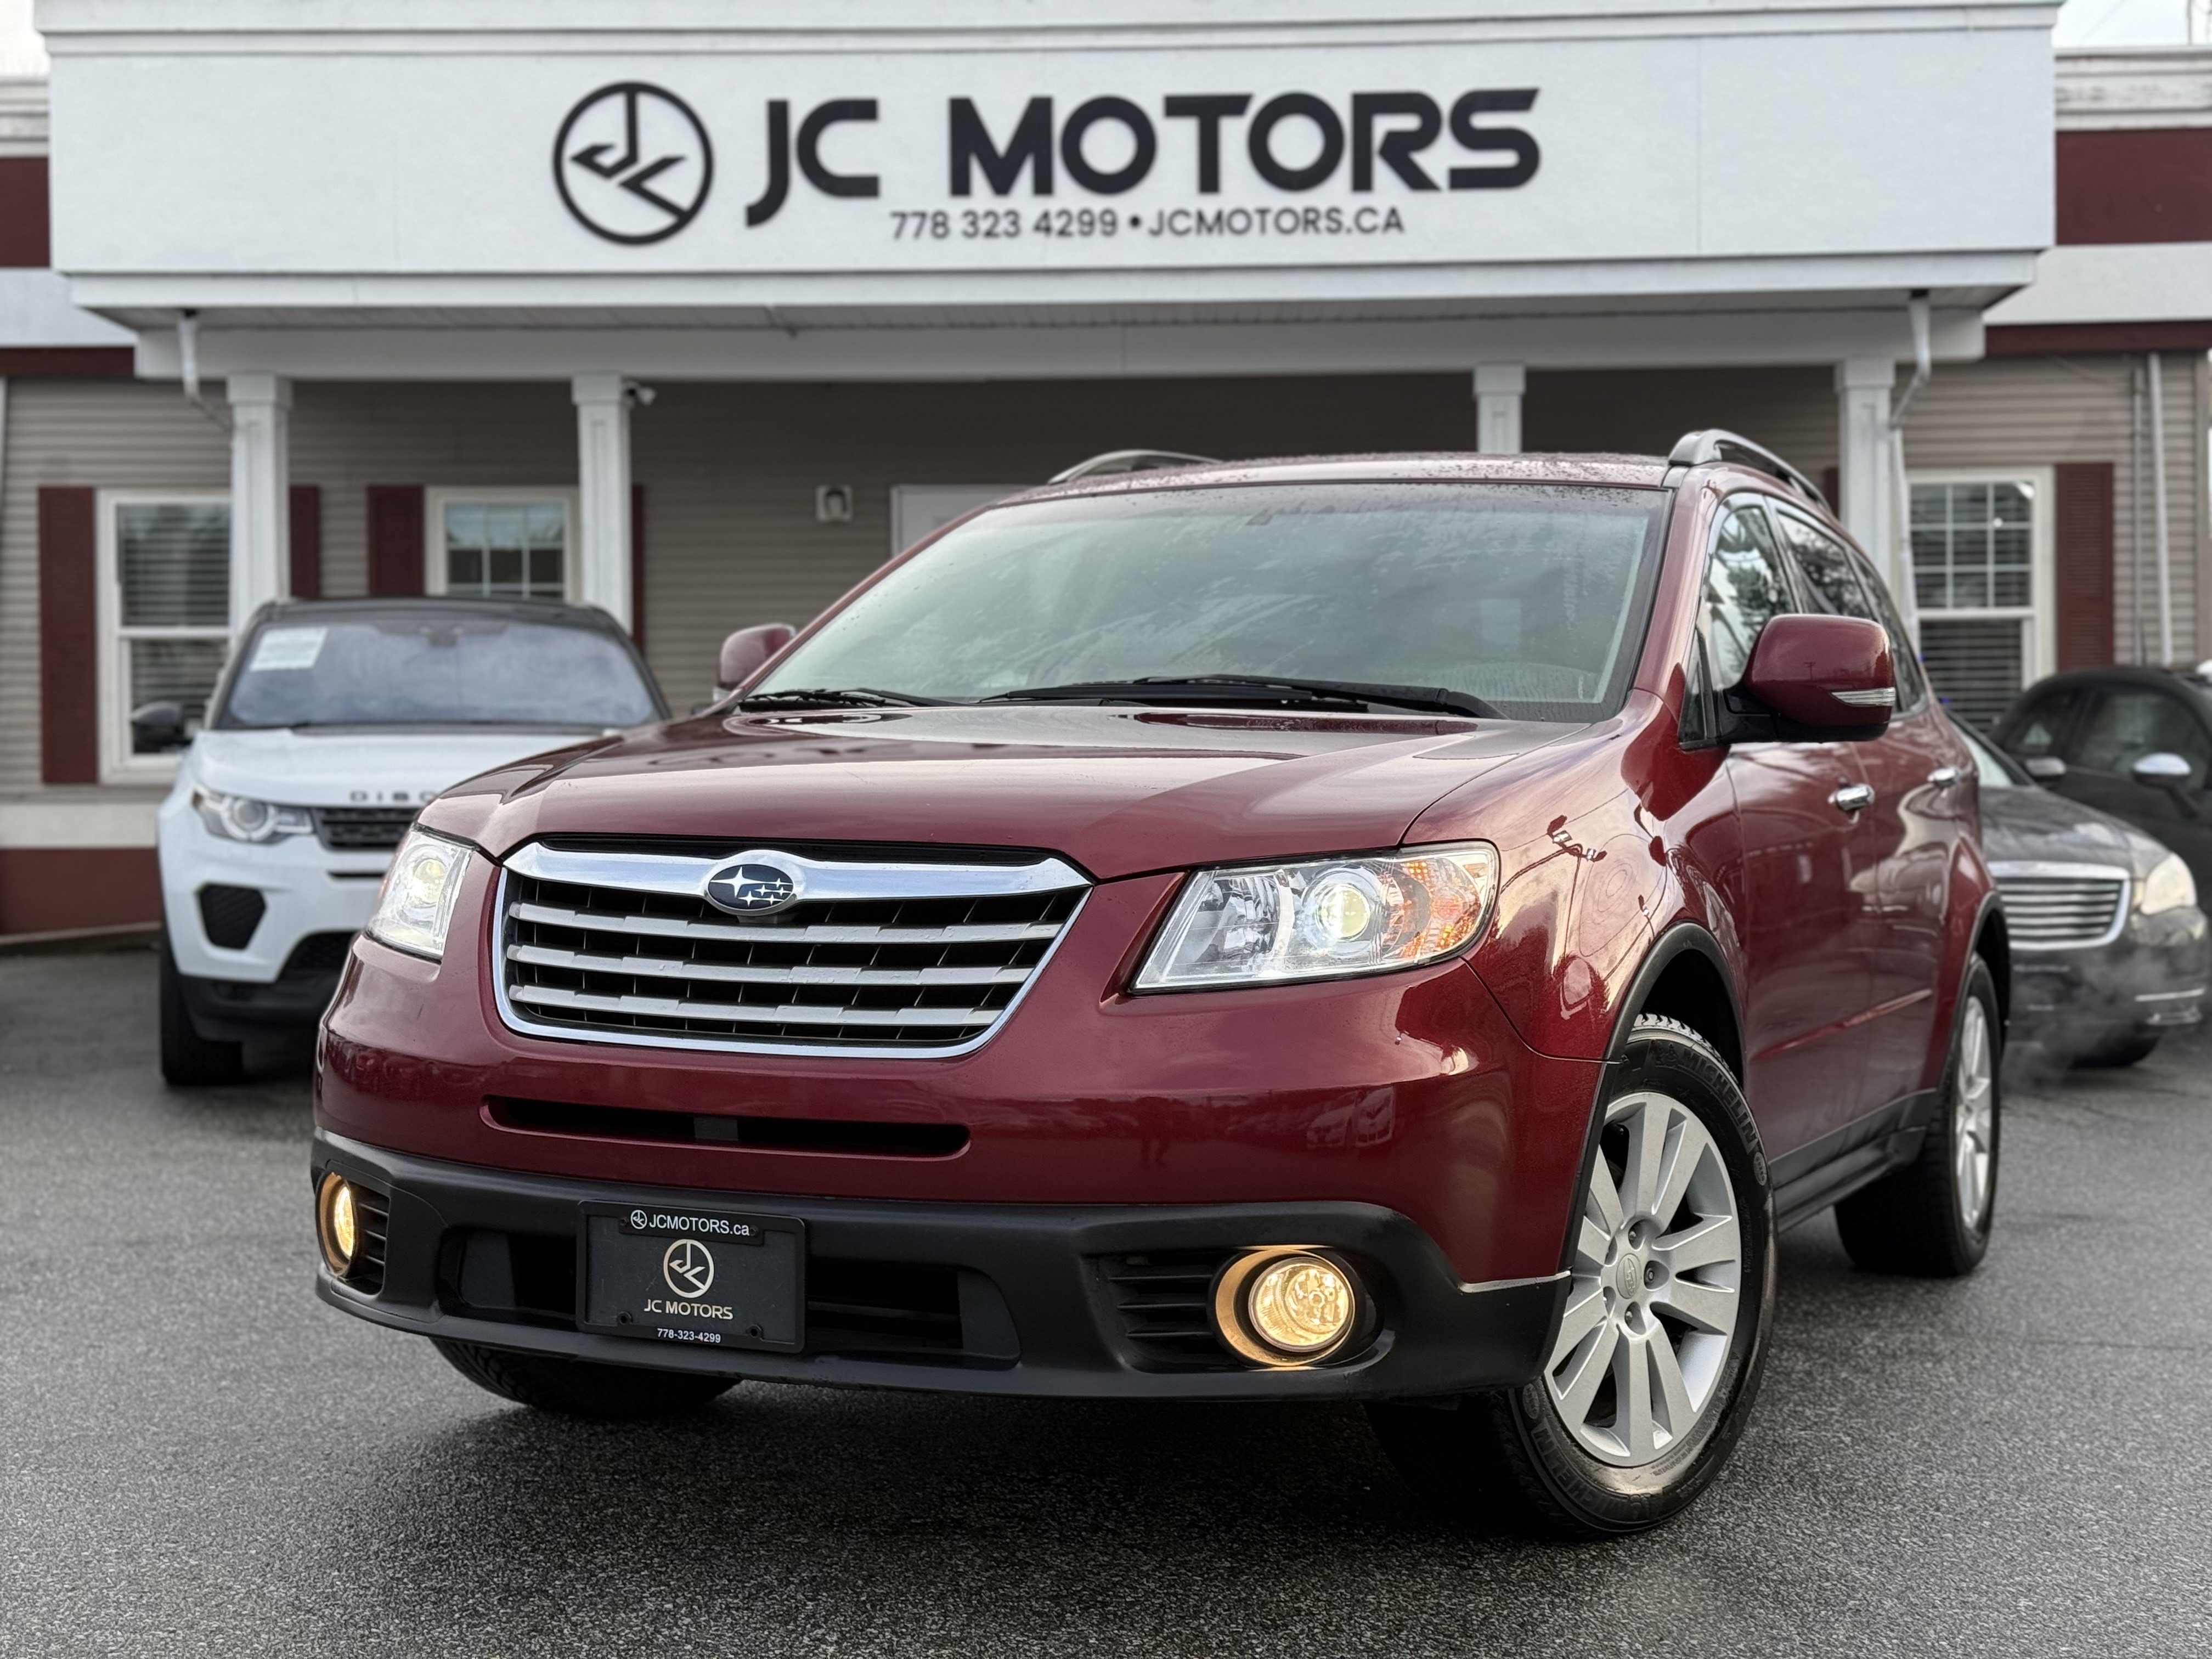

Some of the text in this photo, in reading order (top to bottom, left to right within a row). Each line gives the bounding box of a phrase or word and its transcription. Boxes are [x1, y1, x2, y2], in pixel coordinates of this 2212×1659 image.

[746, 88, 1541, 228] JC MOTORS
[891, 206, 1404, 240] 778 323 4299 JCMOTORS.CA
[649, 1214, 750, 1236] JCMOTORS.ca
[644, 1299, 734, 1320] JC MOTORS
[657, 1328, 721, 1344] 778-323-4299
